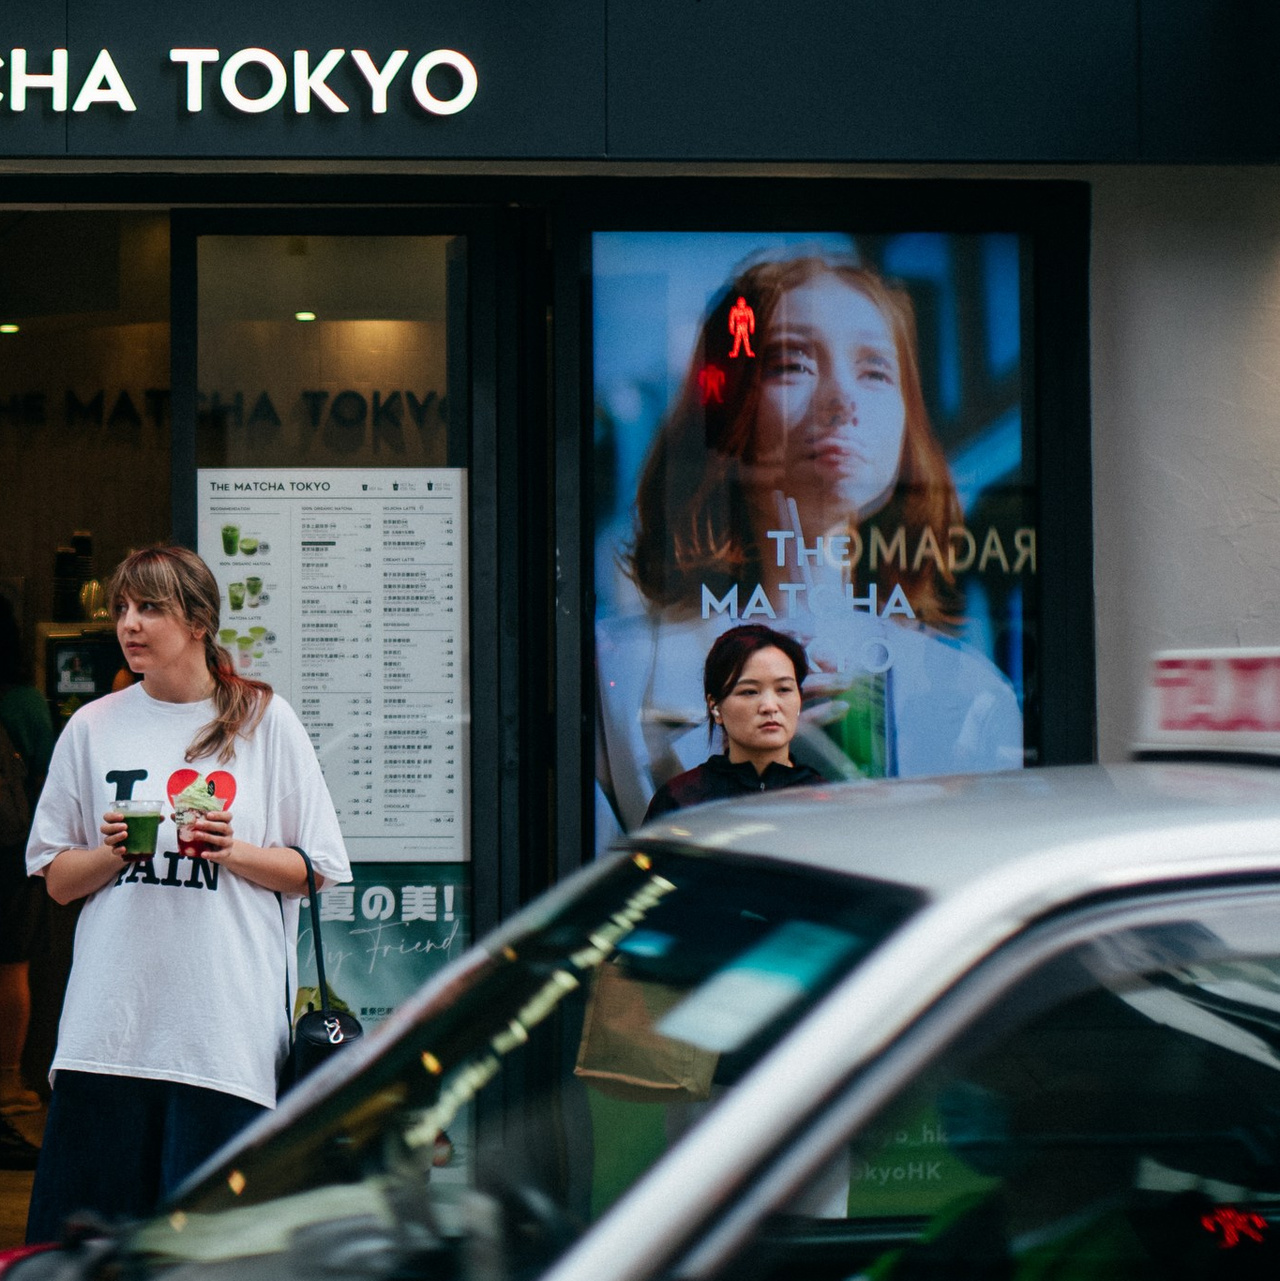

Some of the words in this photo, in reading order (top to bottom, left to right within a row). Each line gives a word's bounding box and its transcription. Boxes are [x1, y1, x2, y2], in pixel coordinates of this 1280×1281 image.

[169, 47, 479, 115] TOKYO
[64, 389, 282, 426] MATHA
[301, 389, 447, 427] TOKY
[210, 481, 230, 491] THE
[234, 481, 285, 492] MATCHA
[289, 481, 331, 492] TOKYO
[767, 531, 851, 567] THE
[700, 582, 917, 620] MATCHA
[115, 851, 220, 891] AIN
